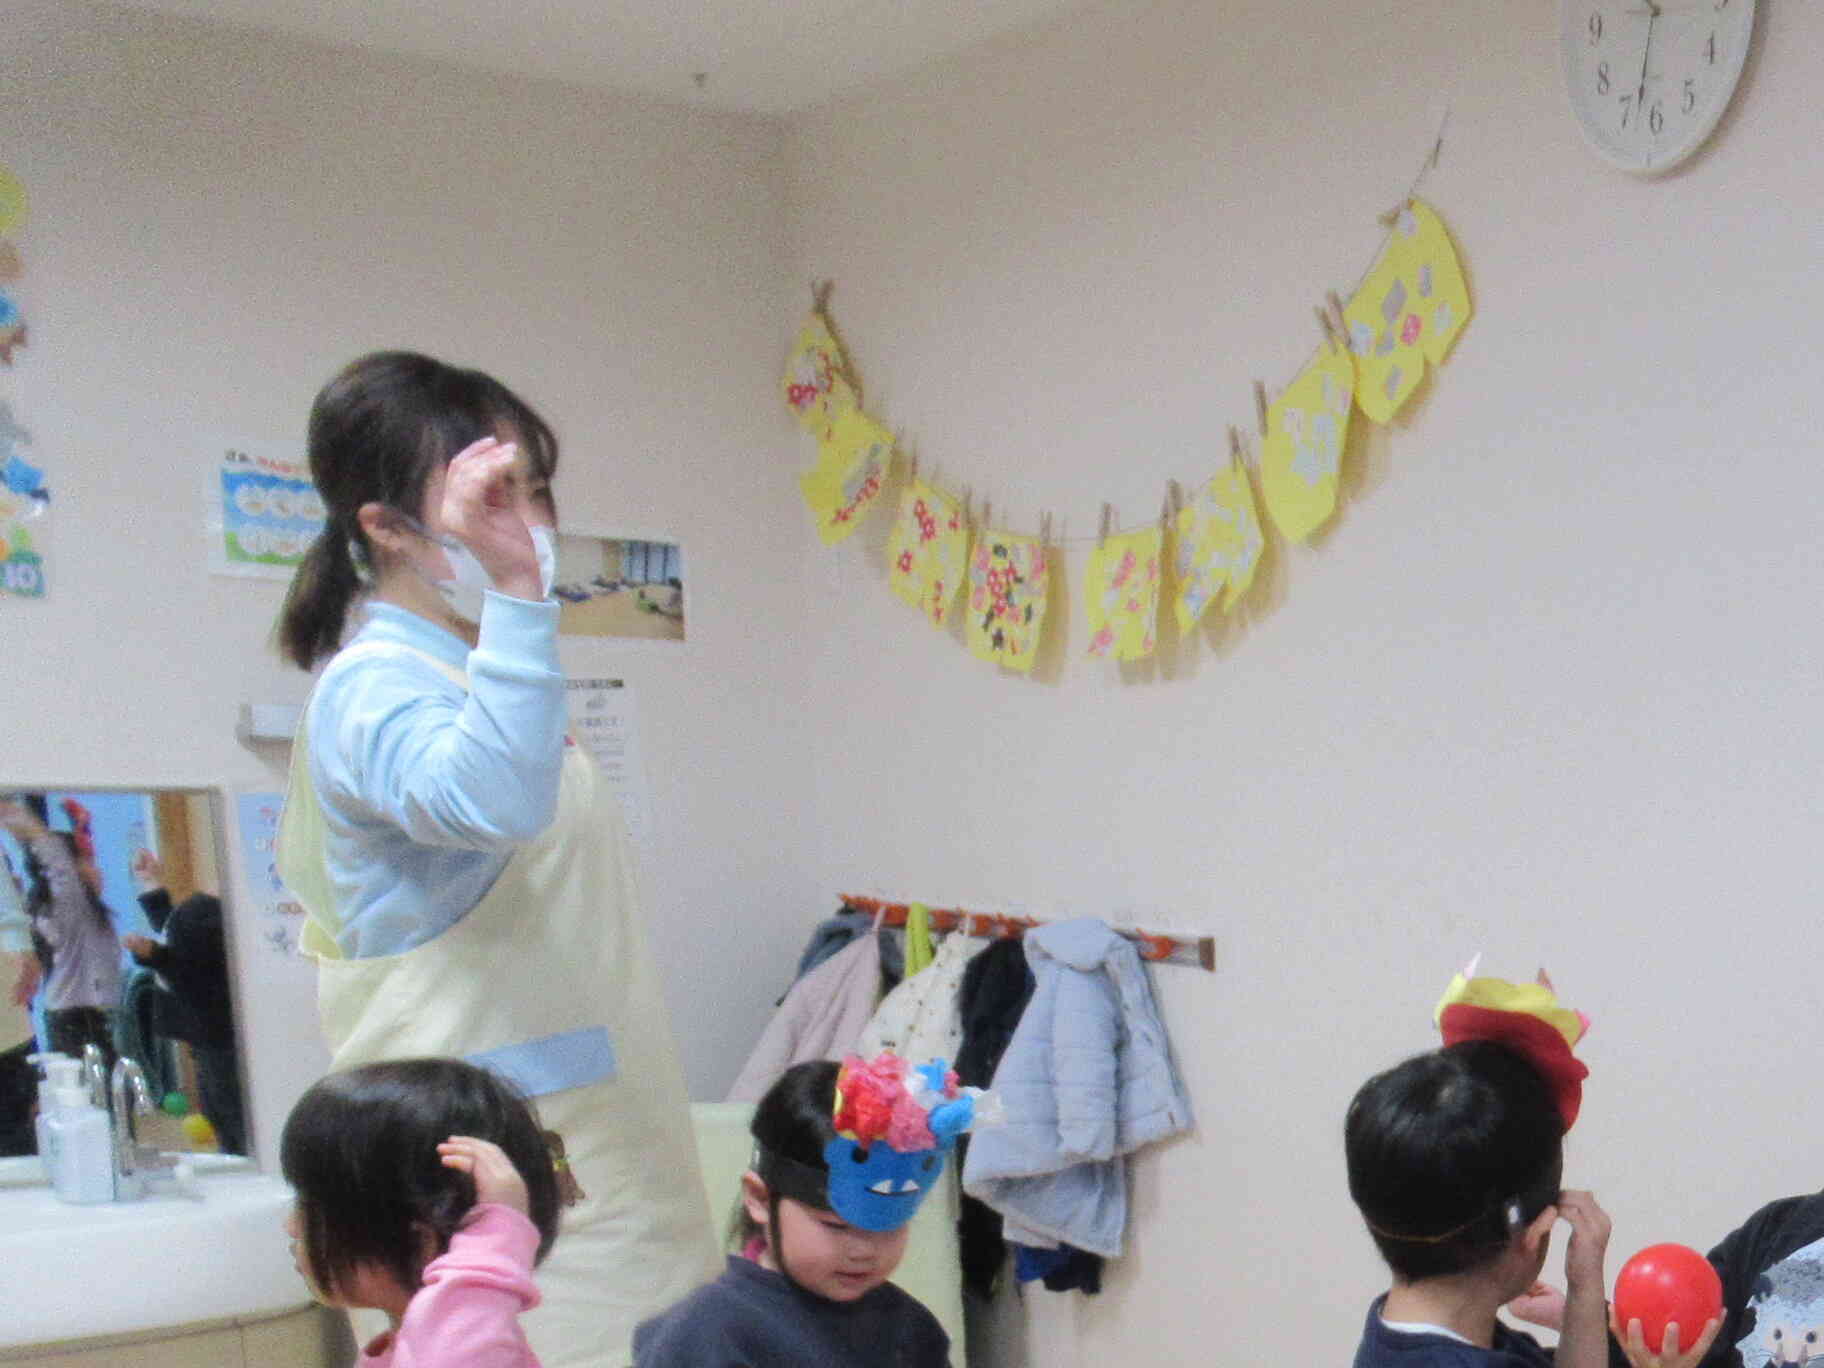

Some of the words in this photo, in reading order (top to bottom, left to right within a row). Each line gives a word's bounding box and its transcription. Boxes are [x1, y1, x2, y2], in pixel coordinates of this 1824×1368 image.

[1702, 30, 1717, 66] 4
[1597, 61, 1610, 96] 8
[1681, 78, 1695, 115] 5
[1618, 94, 1632, 129] 7
[1650, 99, 1663, 135] 6
